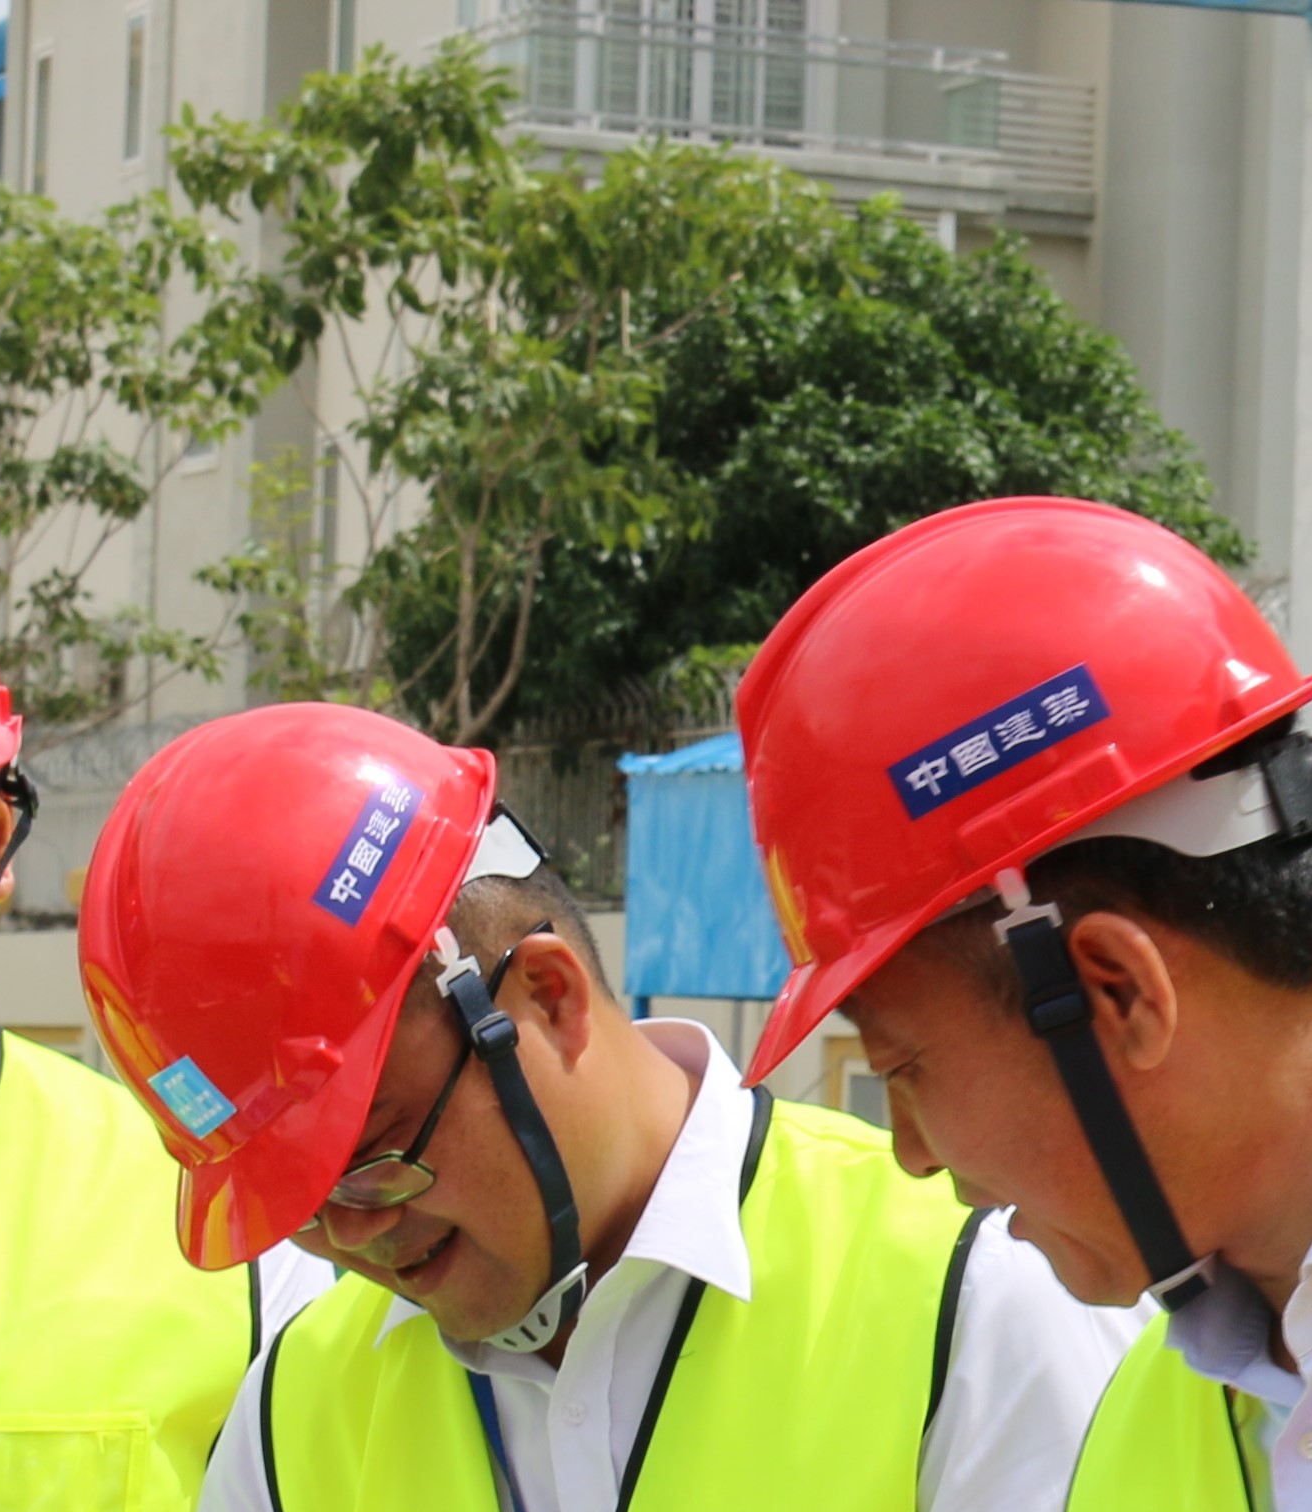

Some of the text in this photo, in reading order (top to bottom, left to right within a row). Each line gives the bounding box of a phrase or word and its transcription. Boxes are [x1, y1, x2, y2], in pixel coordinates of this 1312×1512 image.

[904, 684, 1090, 797] 中國建築
[329, 782, 412, 905] 中國建築
